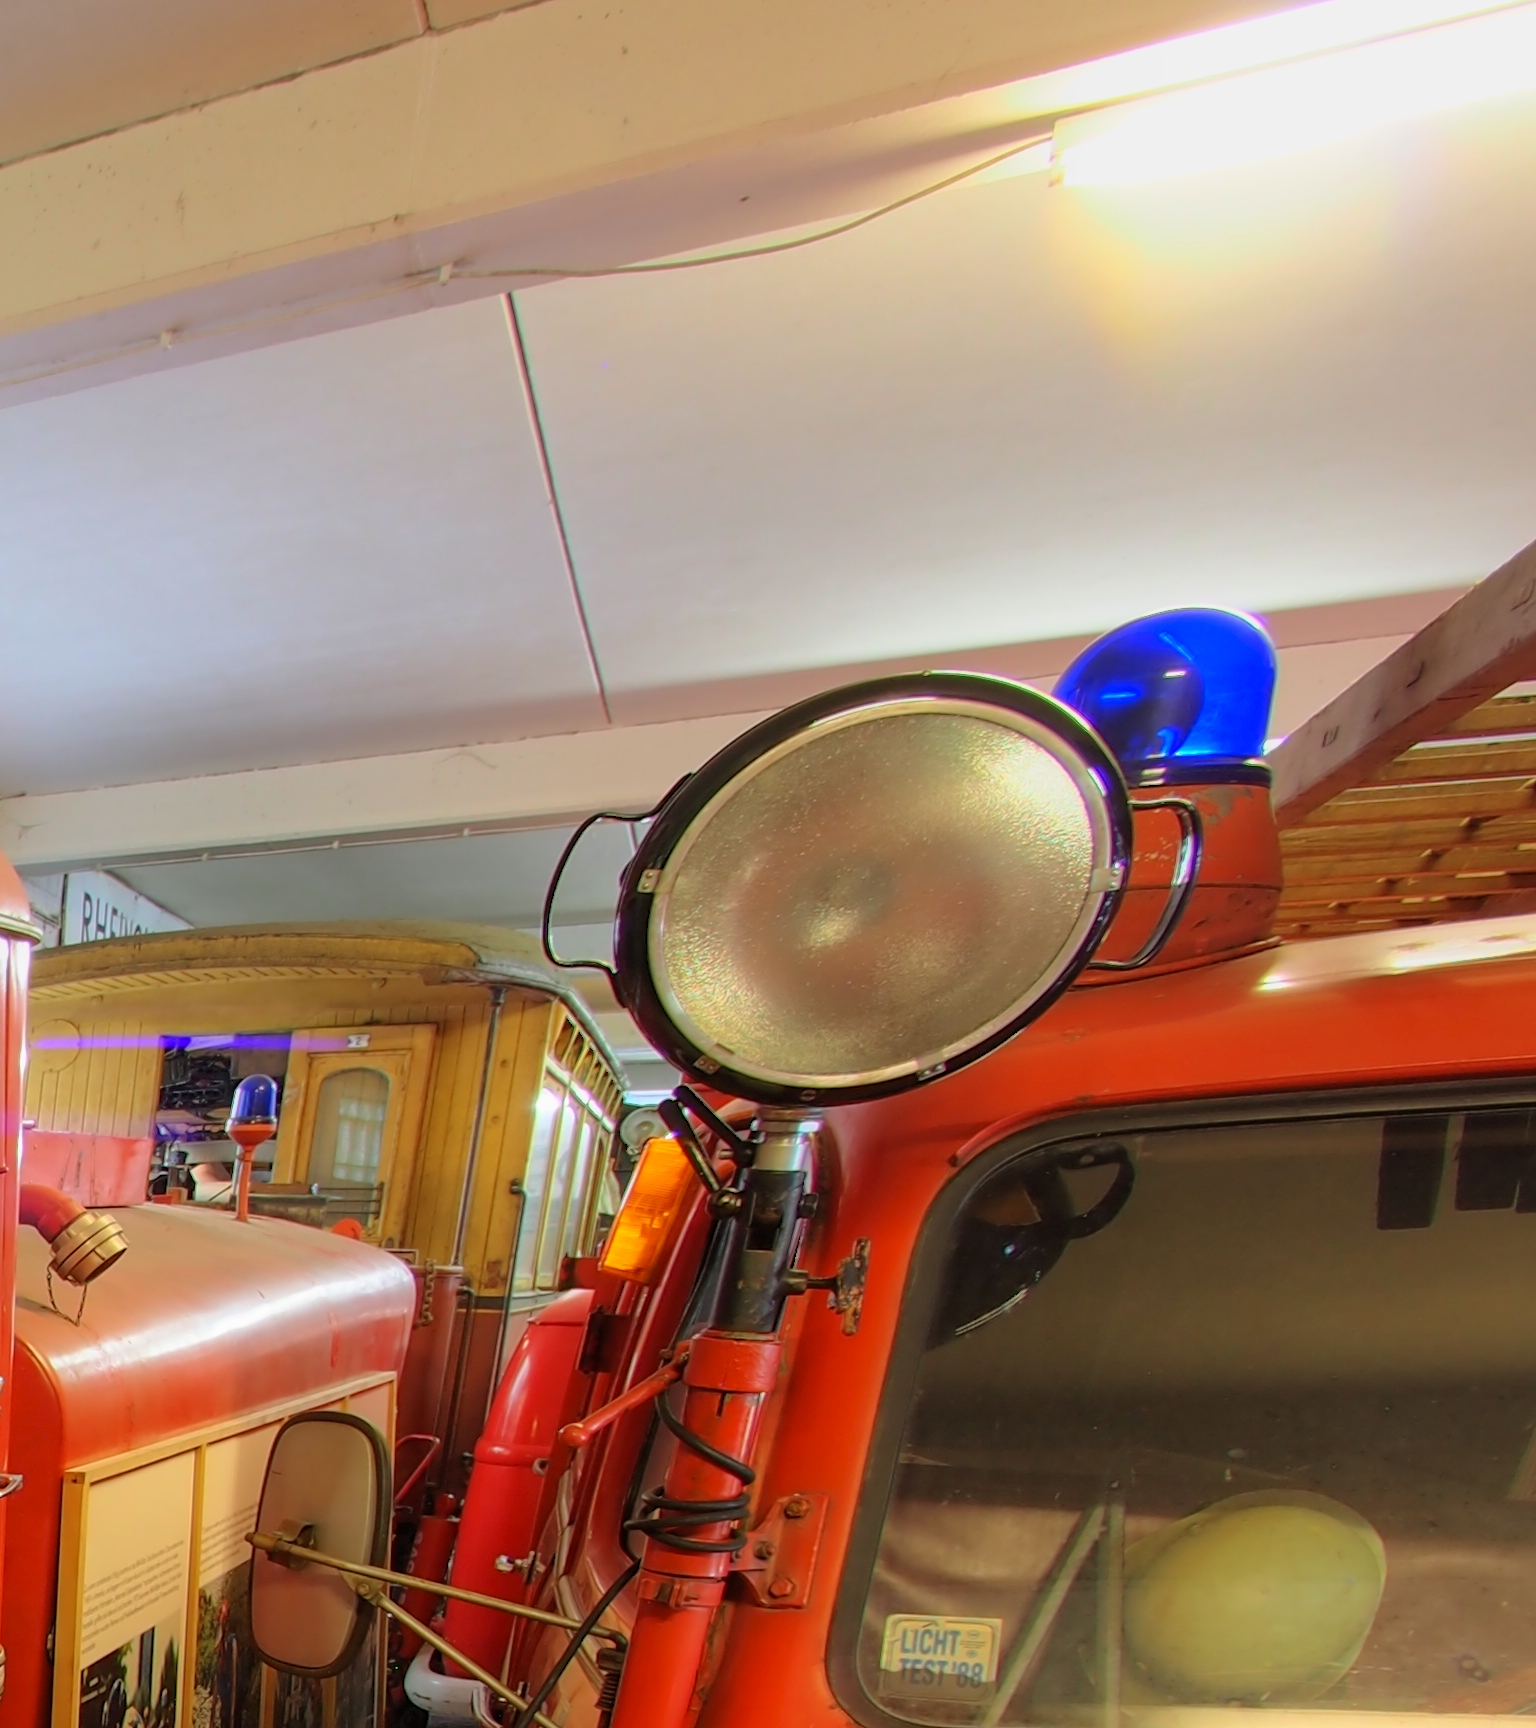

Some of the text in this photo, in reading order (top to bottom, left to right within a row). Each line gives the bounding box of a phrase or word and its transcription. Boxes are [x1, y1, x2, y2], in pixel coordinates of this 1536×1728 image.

[900, 1628, 961, 1657] LICHT
[899, 1658, 984, 1689] TEST '88
